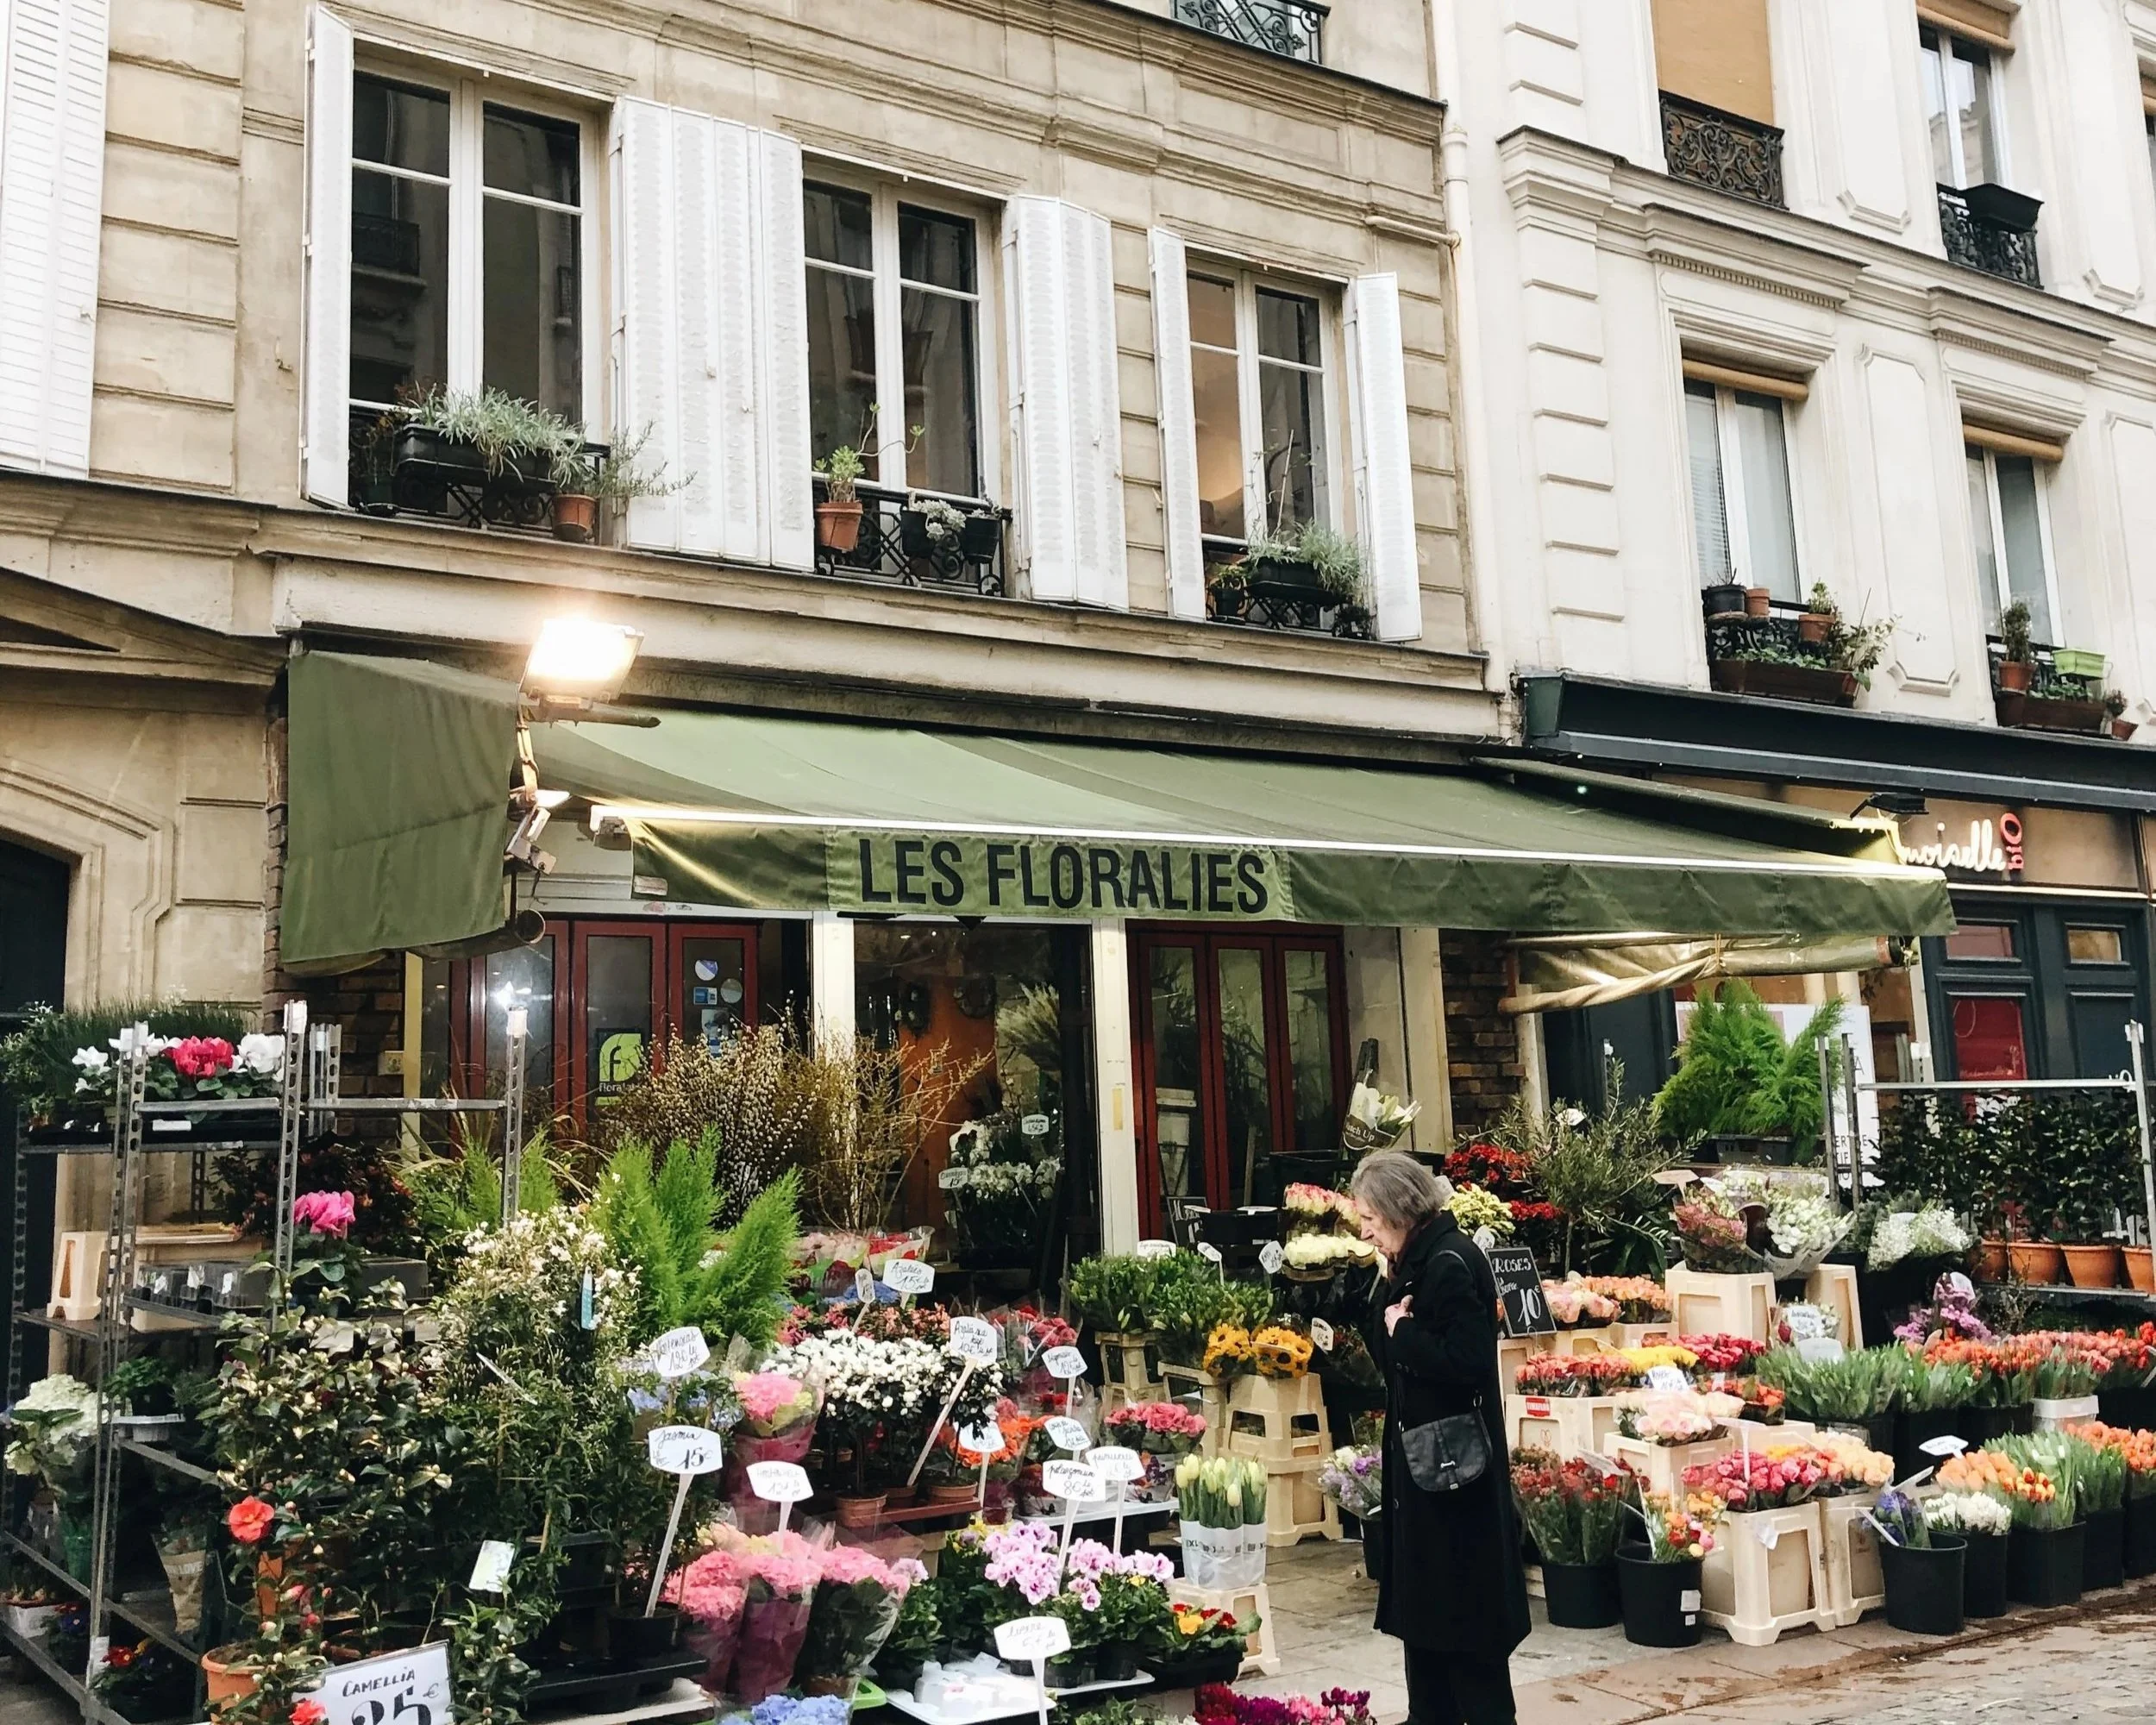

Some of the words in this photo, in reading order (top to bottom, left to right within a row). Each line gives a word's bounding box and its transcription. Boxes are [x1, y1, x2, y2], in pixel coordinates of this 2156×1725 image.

[859, 838, 964, 906] LES
[987, 844, 1268, 913] FLORALIES
[1363, 1130, 1376, 1142] Up
[1493, 1258, 1532, 1273] ROSES
[342, 1666, 415, 1697] CAMELLIA
